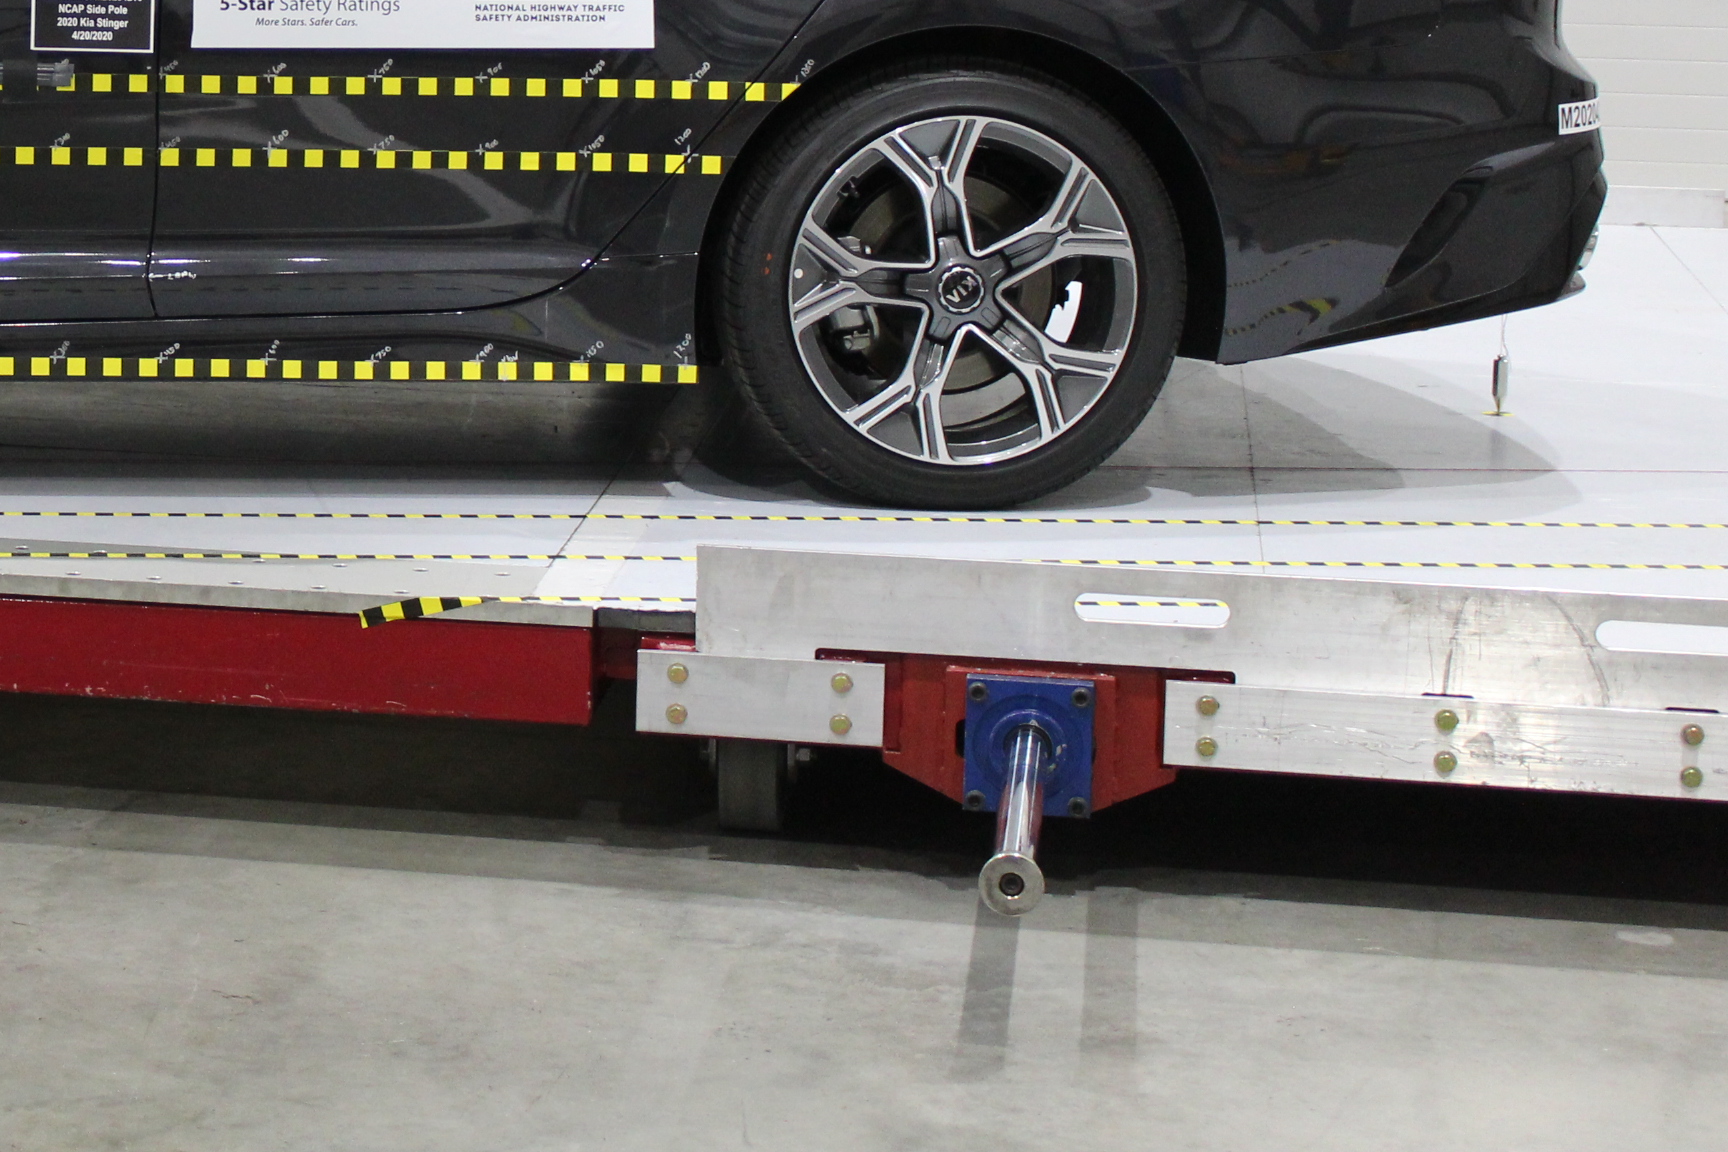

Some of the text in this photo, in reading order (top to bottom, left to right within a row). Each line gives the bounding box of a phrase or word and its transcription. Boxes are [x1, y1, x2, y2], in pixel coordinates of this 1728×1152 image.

[58, 4, 128, 15] NCAP Side Pole
[475, 4, 625, 13] NATIONAL HIGHWAY TRAFFIC
[57, 17, 129, 30] 2020 Kia Stinger
[255, 17, 358, 27] More Stars. Safer Cars.
[475, 14, 606, 23] SAFETY ADMINISTRATION
[71, 31, 113, 41] 4/20/2020
[272, 129, 289, 145] 600
[378, 134, 395, 150] 750
[945, 275, 978, 304] KIA
[375, 345, 392, 359] 750
